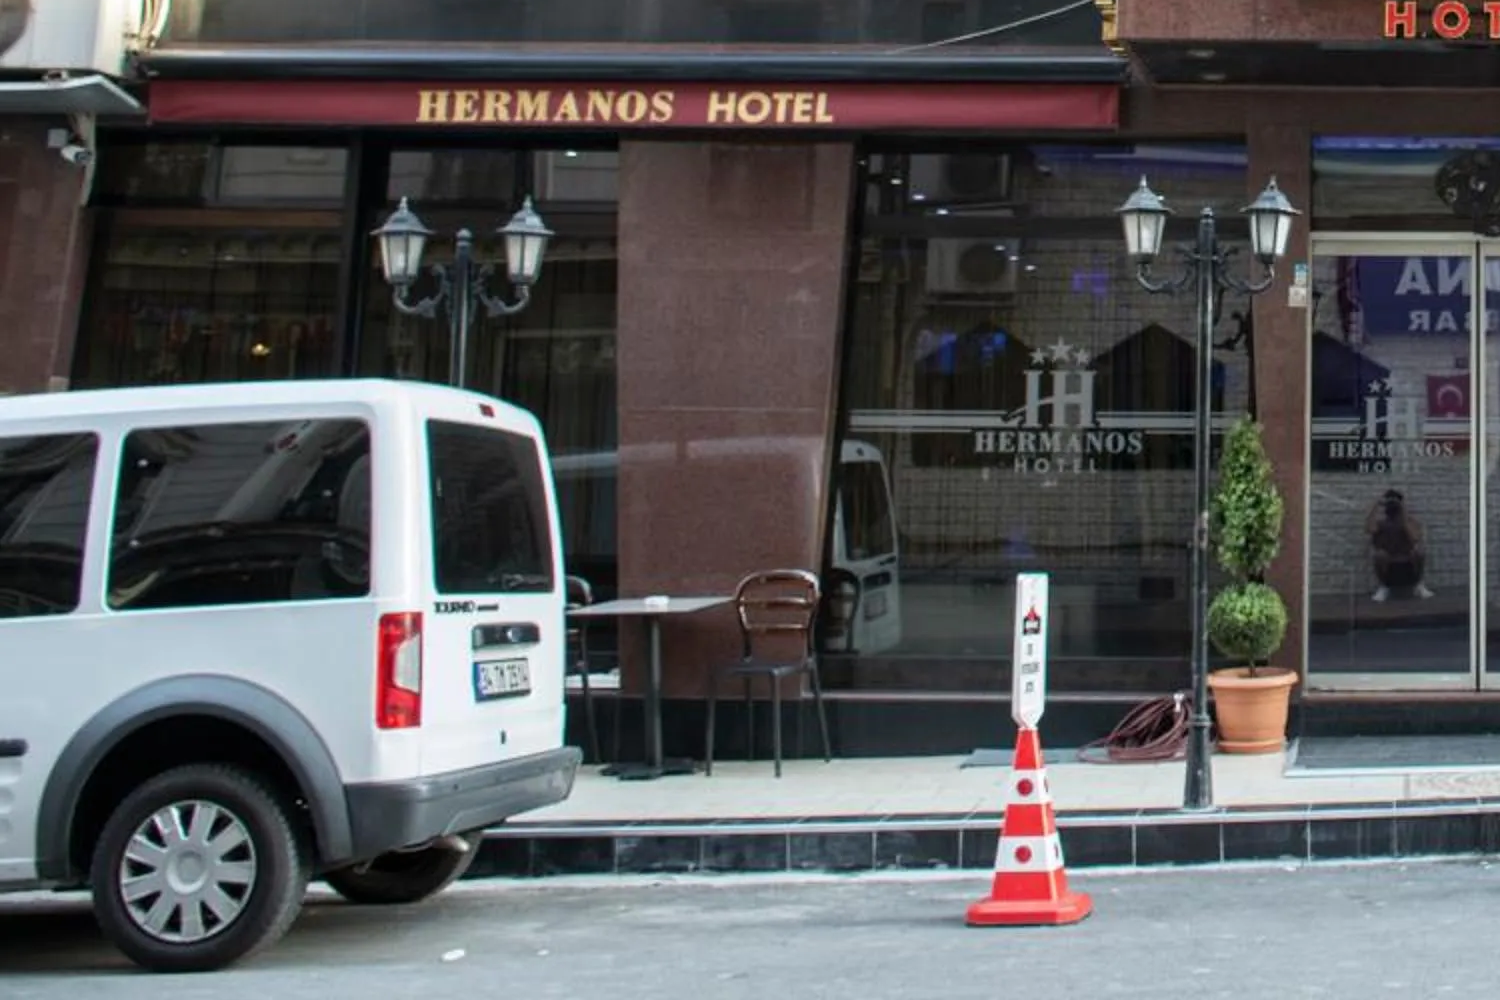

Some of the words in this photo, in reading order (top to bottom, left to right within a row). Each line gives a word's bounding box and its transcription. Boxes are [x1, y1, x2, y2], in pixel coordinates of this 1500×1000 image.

[416, 90, 675, 123] HERMANOS
[707, 91, 834, 124] HOTEL
[974, 429, 1144, 455] HERMANOS
[1329, 440, 1455, 458] HERMANOS
[1013, 458, 1097, 474] HOTEL
